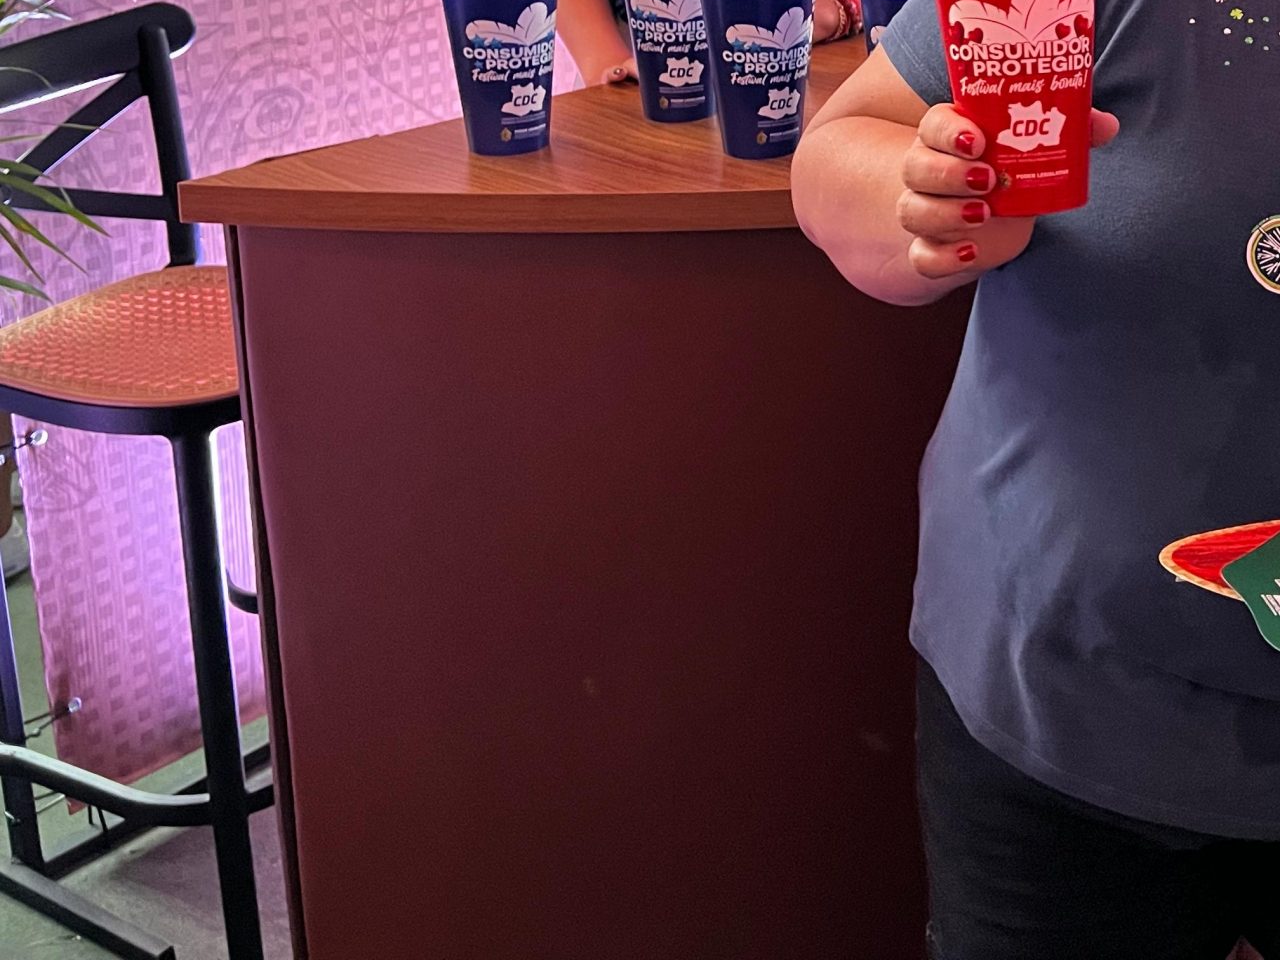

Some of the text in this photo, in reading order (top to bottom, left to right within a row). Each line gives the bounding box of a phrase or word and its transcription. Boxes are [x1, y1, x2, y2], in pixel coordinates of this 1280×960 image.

[630, 17, 705, 33] CONSUMID
[645, 30, 707, 43] PROTEG
[463, 40, 555, 60] CONSUMIDO
[722, 43, 810, 63] CONSUMIDO
[949, 35, 1090, 62] CONSUMIDOR
[485, 51, 554, 70] PROTEGI
[972, 53, 1093, 77] PROTEGIDO
[669, 66, 694, 78] CDC
[959, 69, 1089, 96] Festival mais bonito!
[513, 92, 538, 107] CDC
[769, 96, 793, 111] CDC
[1012, 117, 1051, 138] CDC
